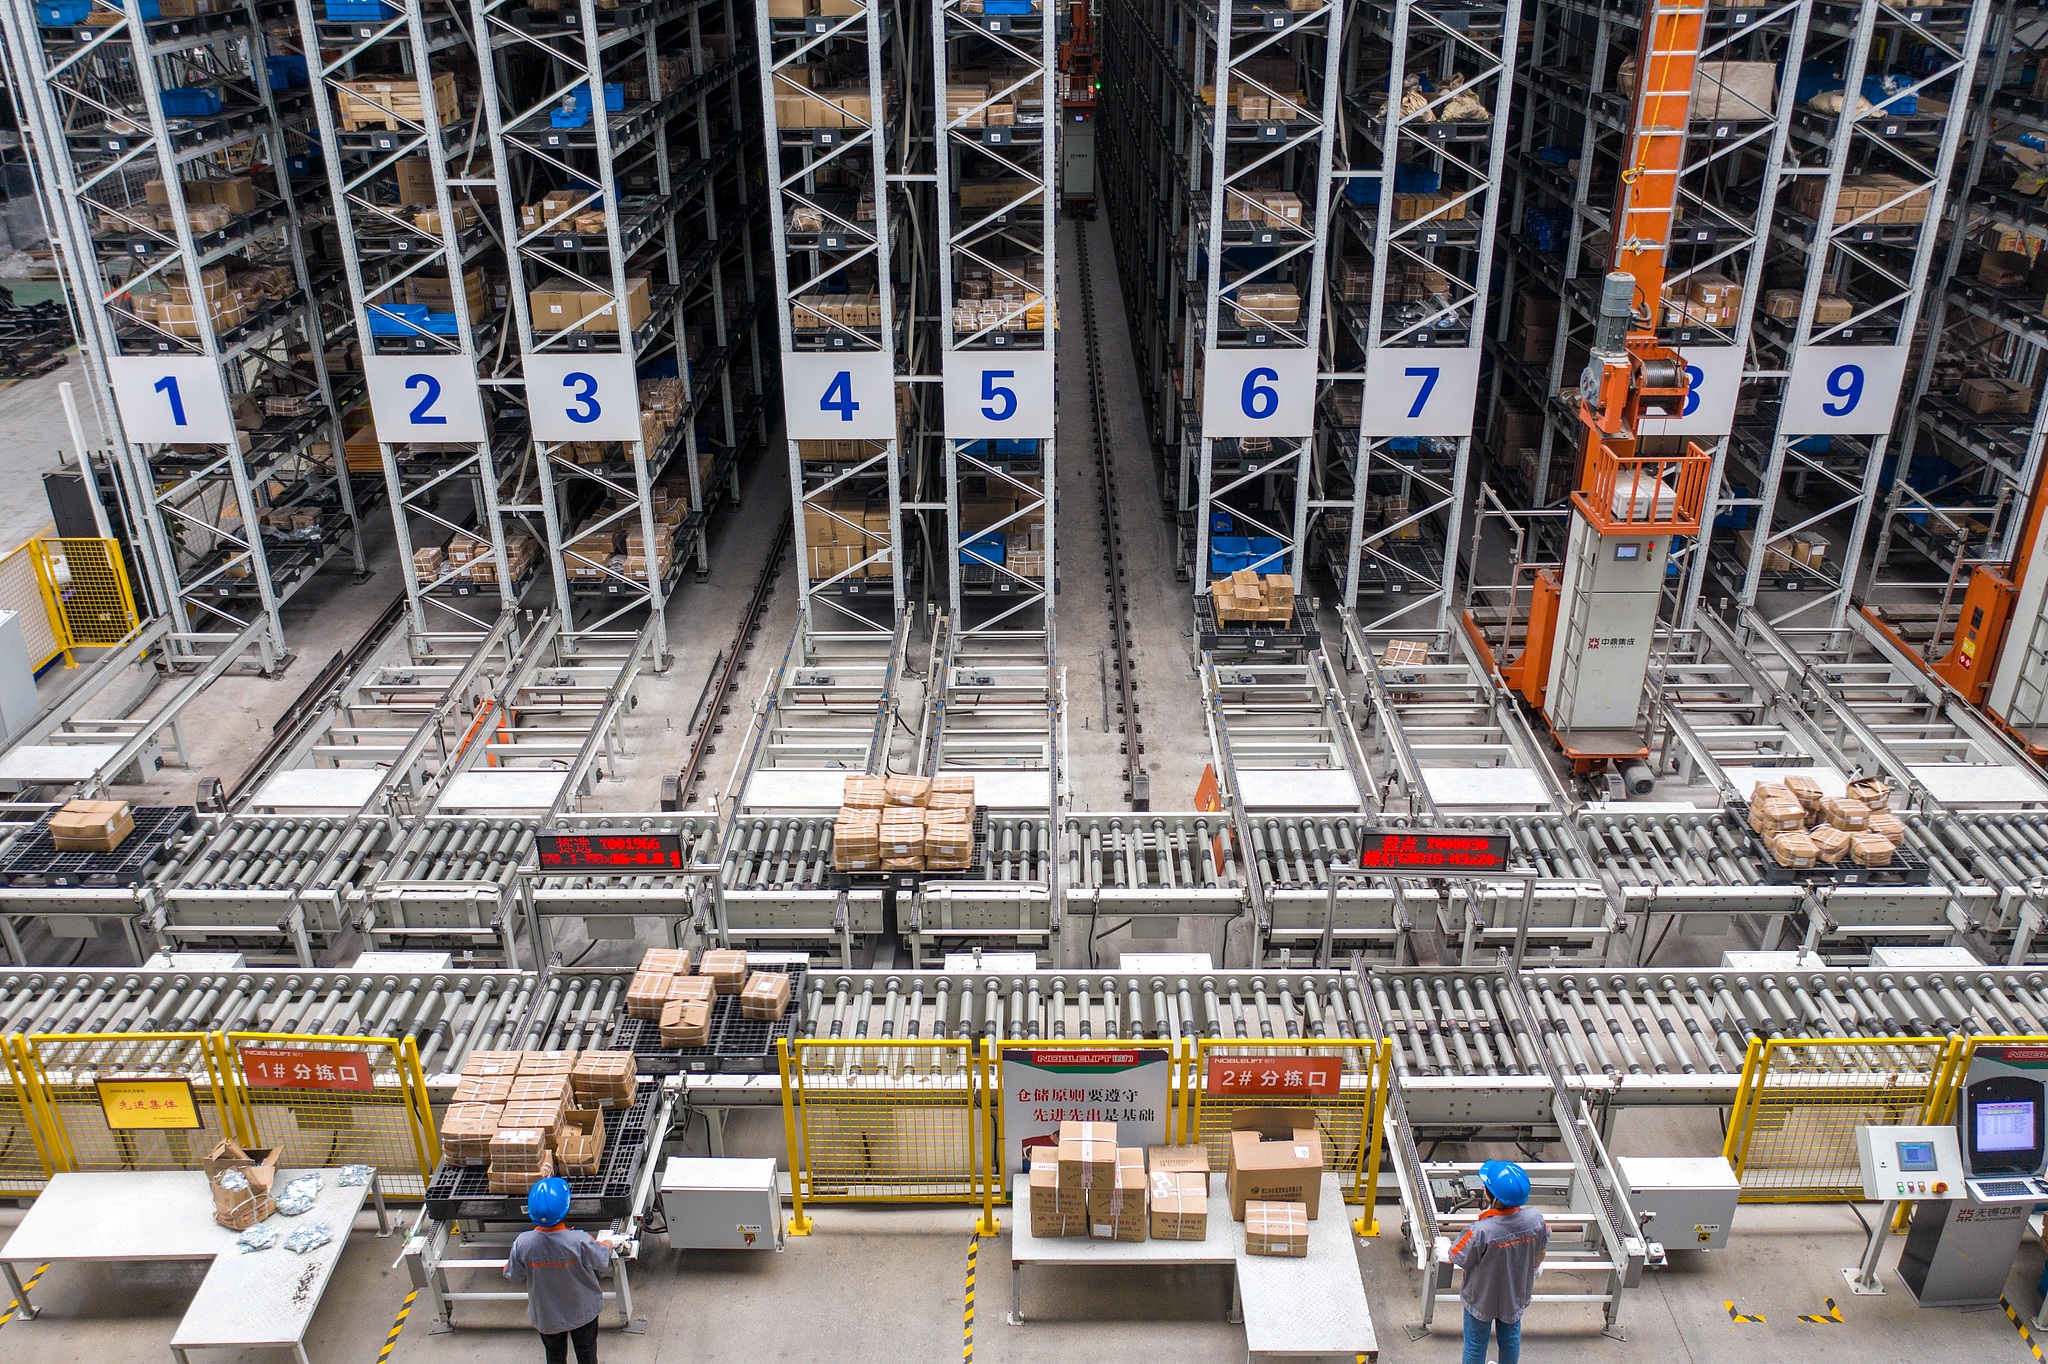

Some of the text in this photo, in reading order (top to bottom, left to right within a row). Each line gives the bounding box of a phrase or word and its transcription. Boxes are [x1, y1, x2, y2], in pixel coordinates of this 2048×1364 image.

[154, 376, 186, 426] 1
[405, 374, 446, 424] 2
[563, 372, 601, 424] 3
[820, 371, 859, 421] 4
[981, 370, 1017, 421] 5
[1241, 368, 1278, 420] 6
[1401, 367, 1440, 418] 7
[1823, 364, 1864, 416] 9
[557, 836, 593, 853] 拣选
[258, 1062, 358, 1081] 1# 分拣口
[1037, 1054, 1111, 1063] NOBLELIFT
[1017, 1088, 1138, 1103] 仓储原则要遵守
[1222, 1070, 1327, 1087] 2# 分拣口
[119, 1099, 178, 1111] 先进集体
[1033, 1108, 1155, 1122] 先进先出是基础
[1976, 1206, 2023, 1218] 无锡中鼎
